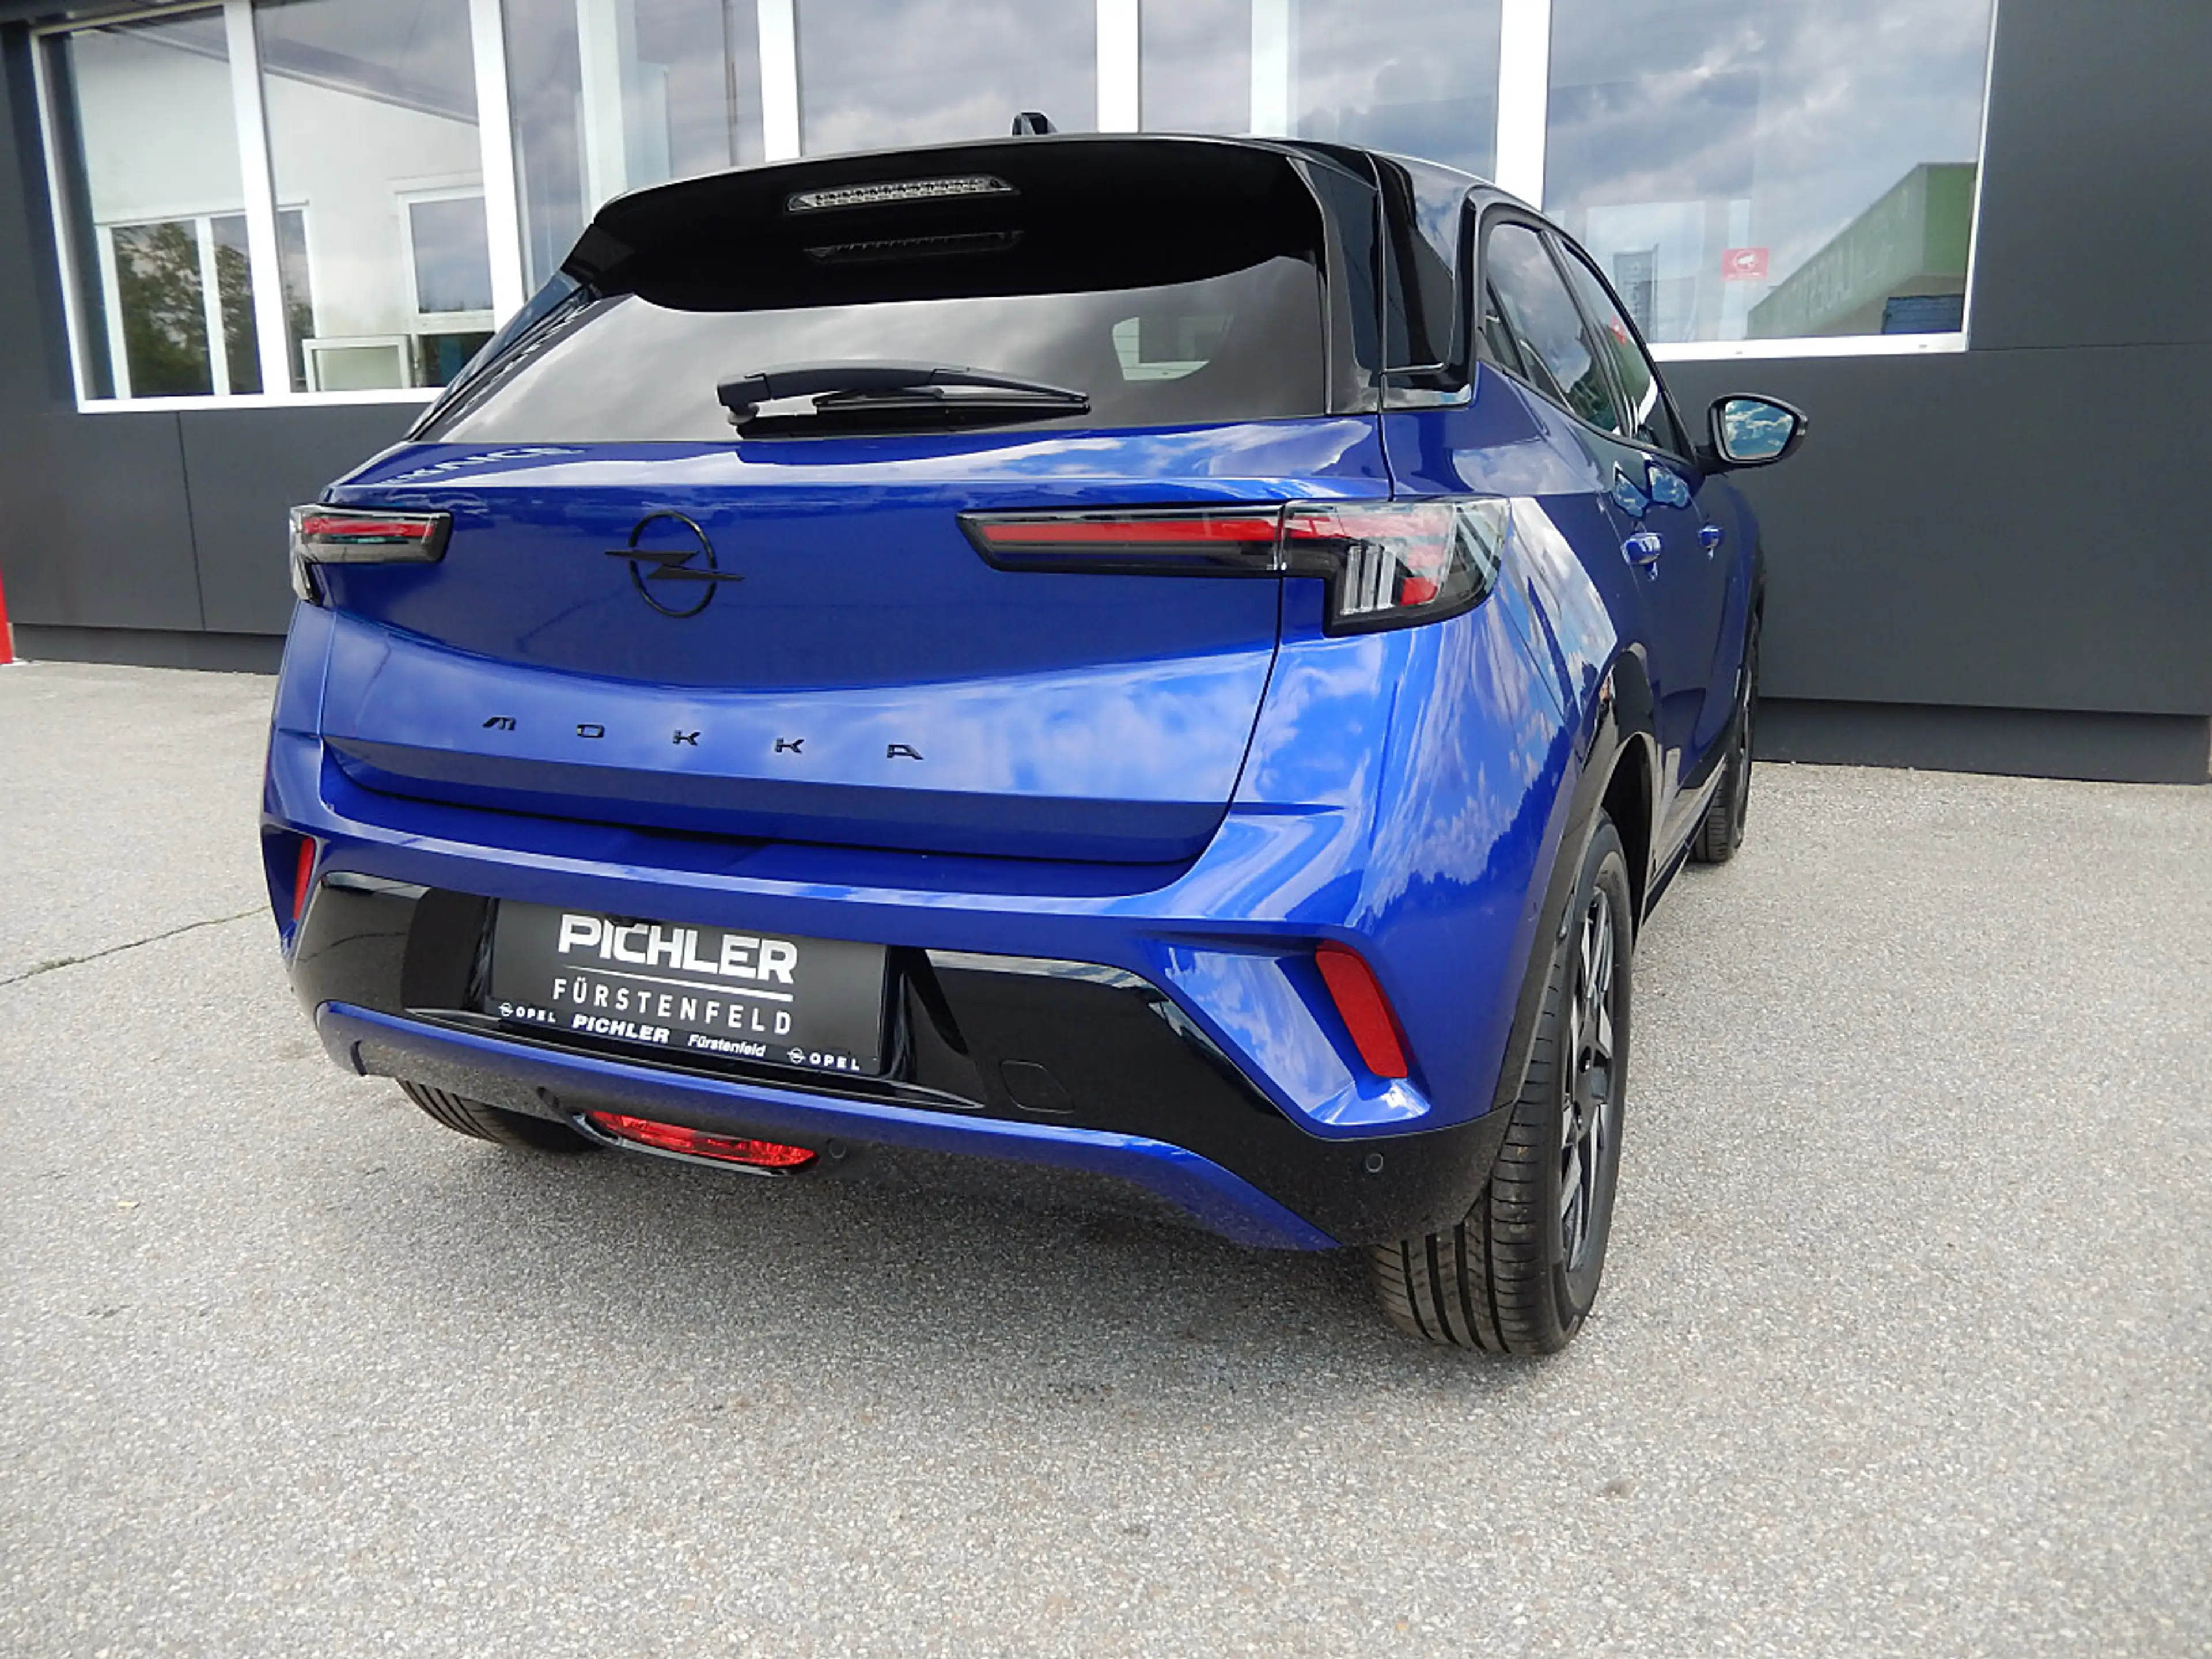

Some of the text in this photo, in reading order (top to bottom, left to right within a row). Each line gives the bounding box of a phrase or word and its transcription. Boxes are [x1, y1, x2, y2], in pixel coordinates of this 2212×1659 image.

[482, 716, 923, 760] MOKKA
[558, 914, 798, 983] PICHLER
[553, 977, 792, 1035] FÜRSTENFELD
[517, 1006, 861, 1071] OPEL PICHLER Fürstenfeld OPEL
